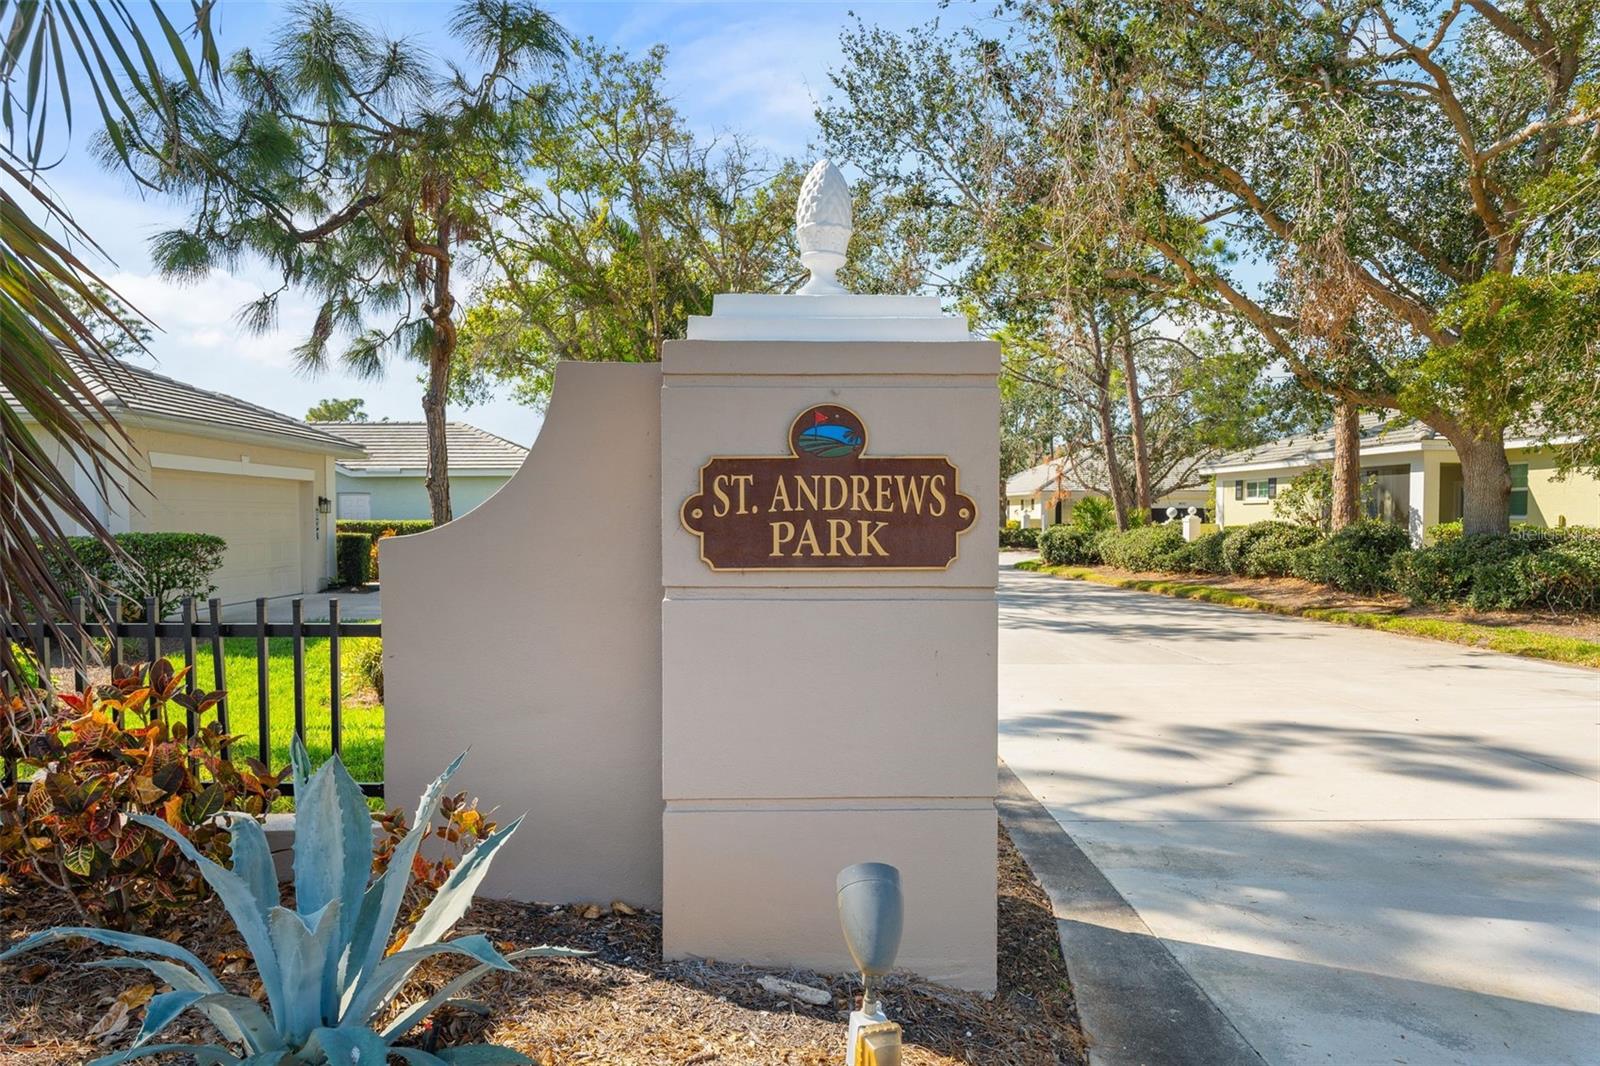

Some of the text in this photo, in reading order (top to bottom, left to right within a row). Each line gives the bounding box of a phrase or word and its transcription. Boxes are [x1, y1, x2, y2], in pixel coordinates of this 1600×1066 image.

[712, 474, 947, 517] ST. ANDREWS
[768, 518, 890, 557] PARK
